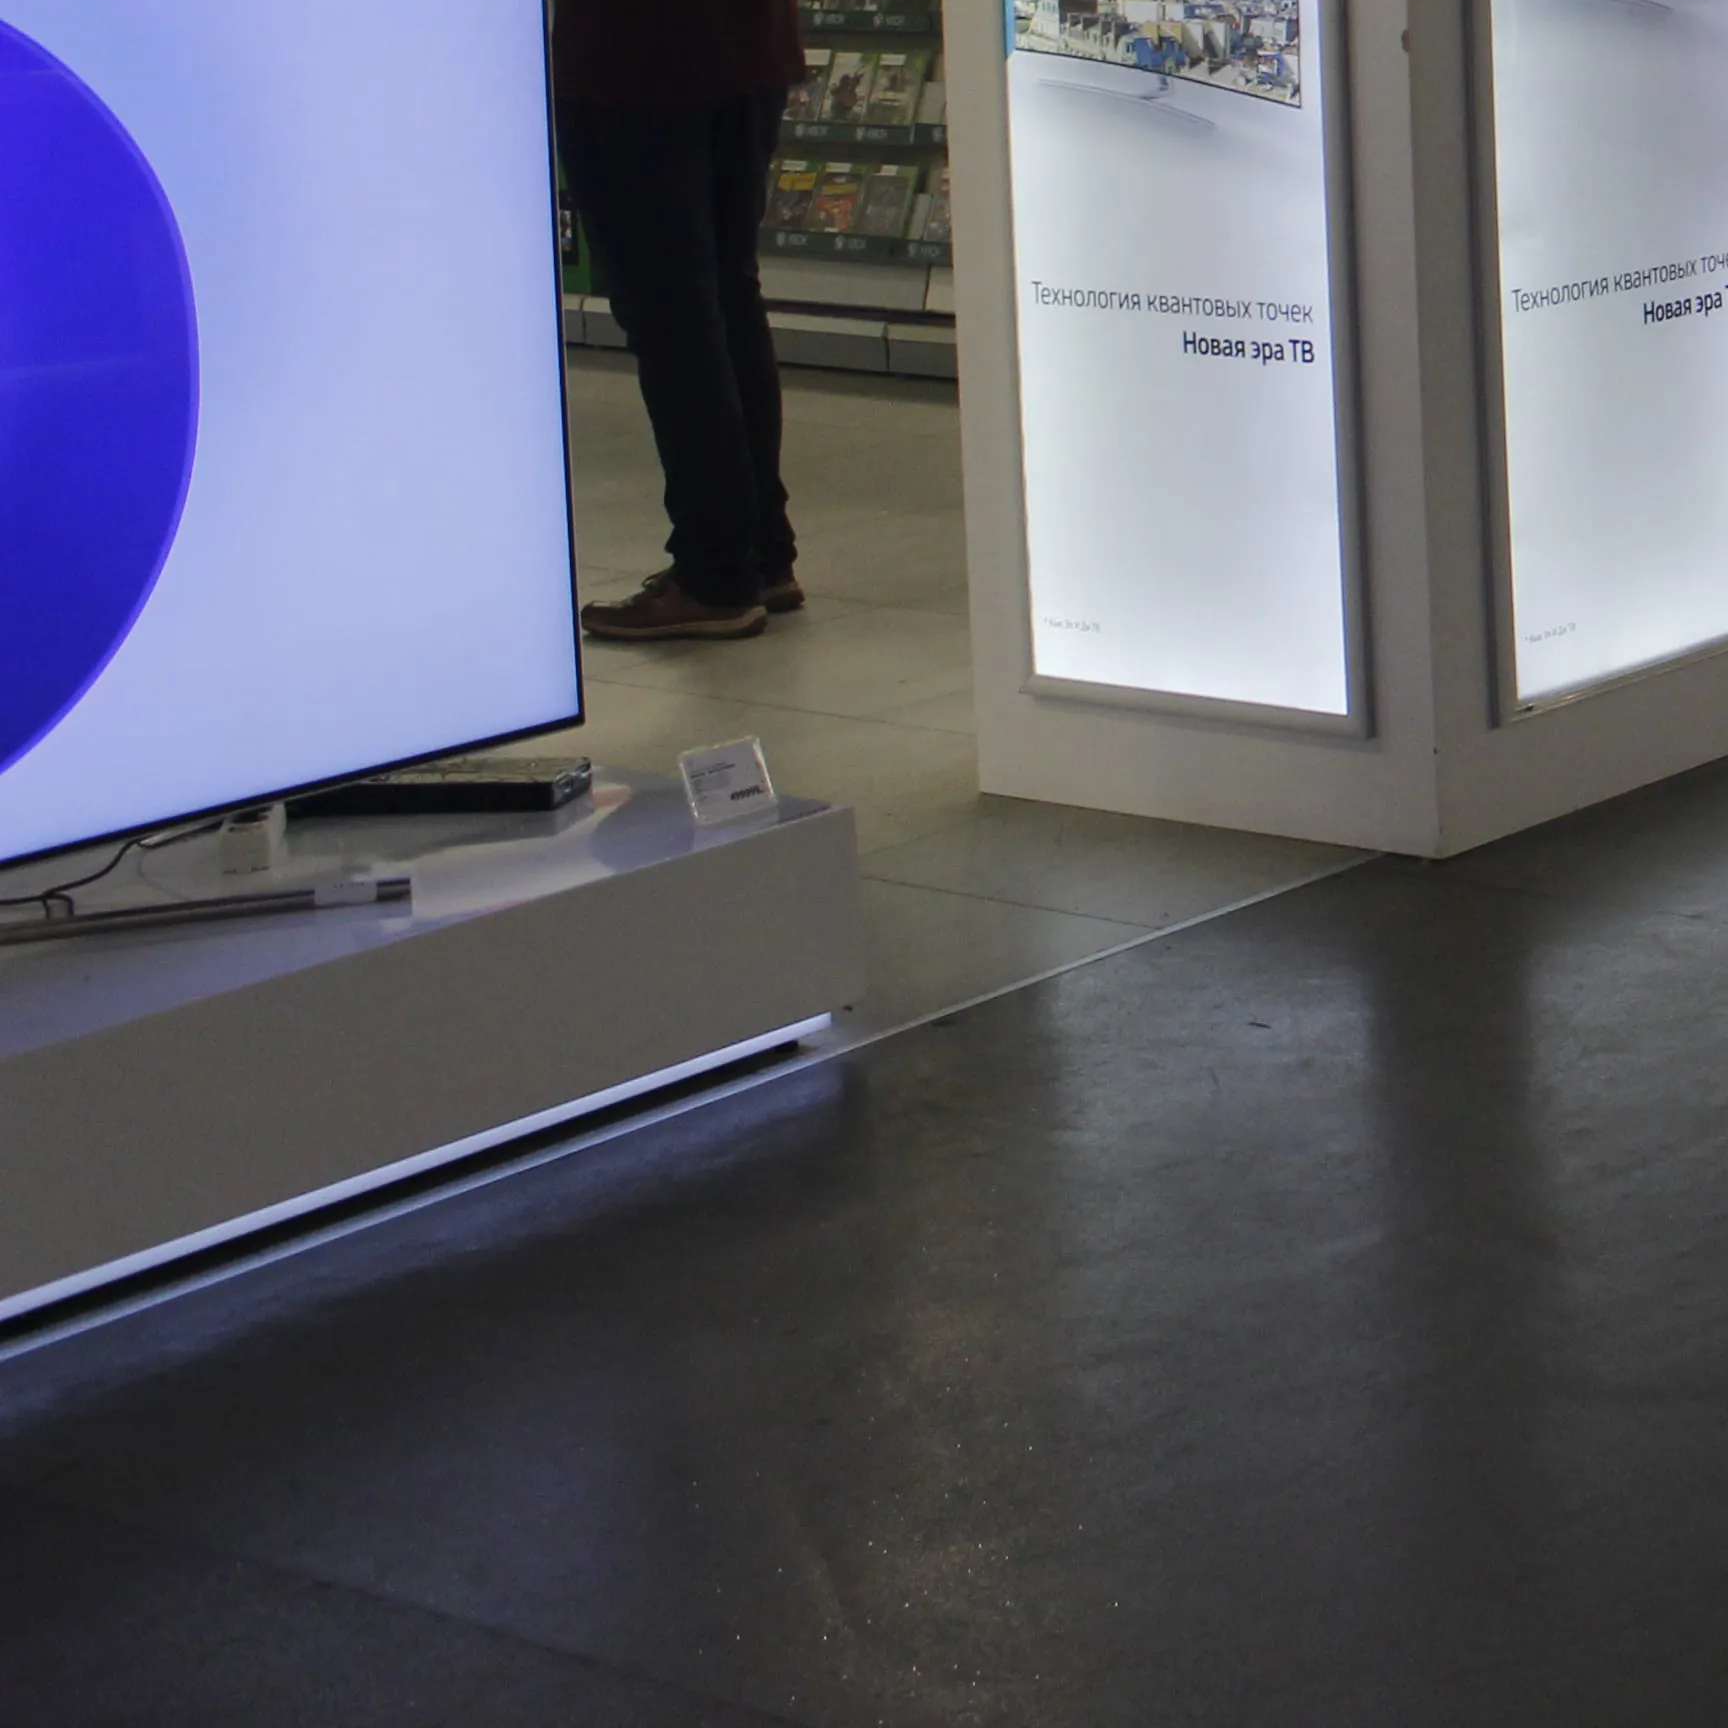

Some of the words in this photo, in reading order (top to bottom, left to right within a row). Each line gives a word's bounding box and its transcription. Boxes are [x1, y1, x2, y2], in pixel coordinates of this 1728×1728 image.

[1031, 280, 1142, 312] Технология
[1147, 294, 1253, 320] квантовых
[1256, 301, 1314, 324] точек
[1512, 276, 1609, 313] Технология
[1613, 258, 1697, 293] квантовых
[1643, 299, 1693, 325] Новая
[1695, 290, 1723, 318] эра
[1182, 330, 1247, 359] Новая
[1250, 341, 1286, 366] эра
[1288, 338, 1316, 364] ТВ
